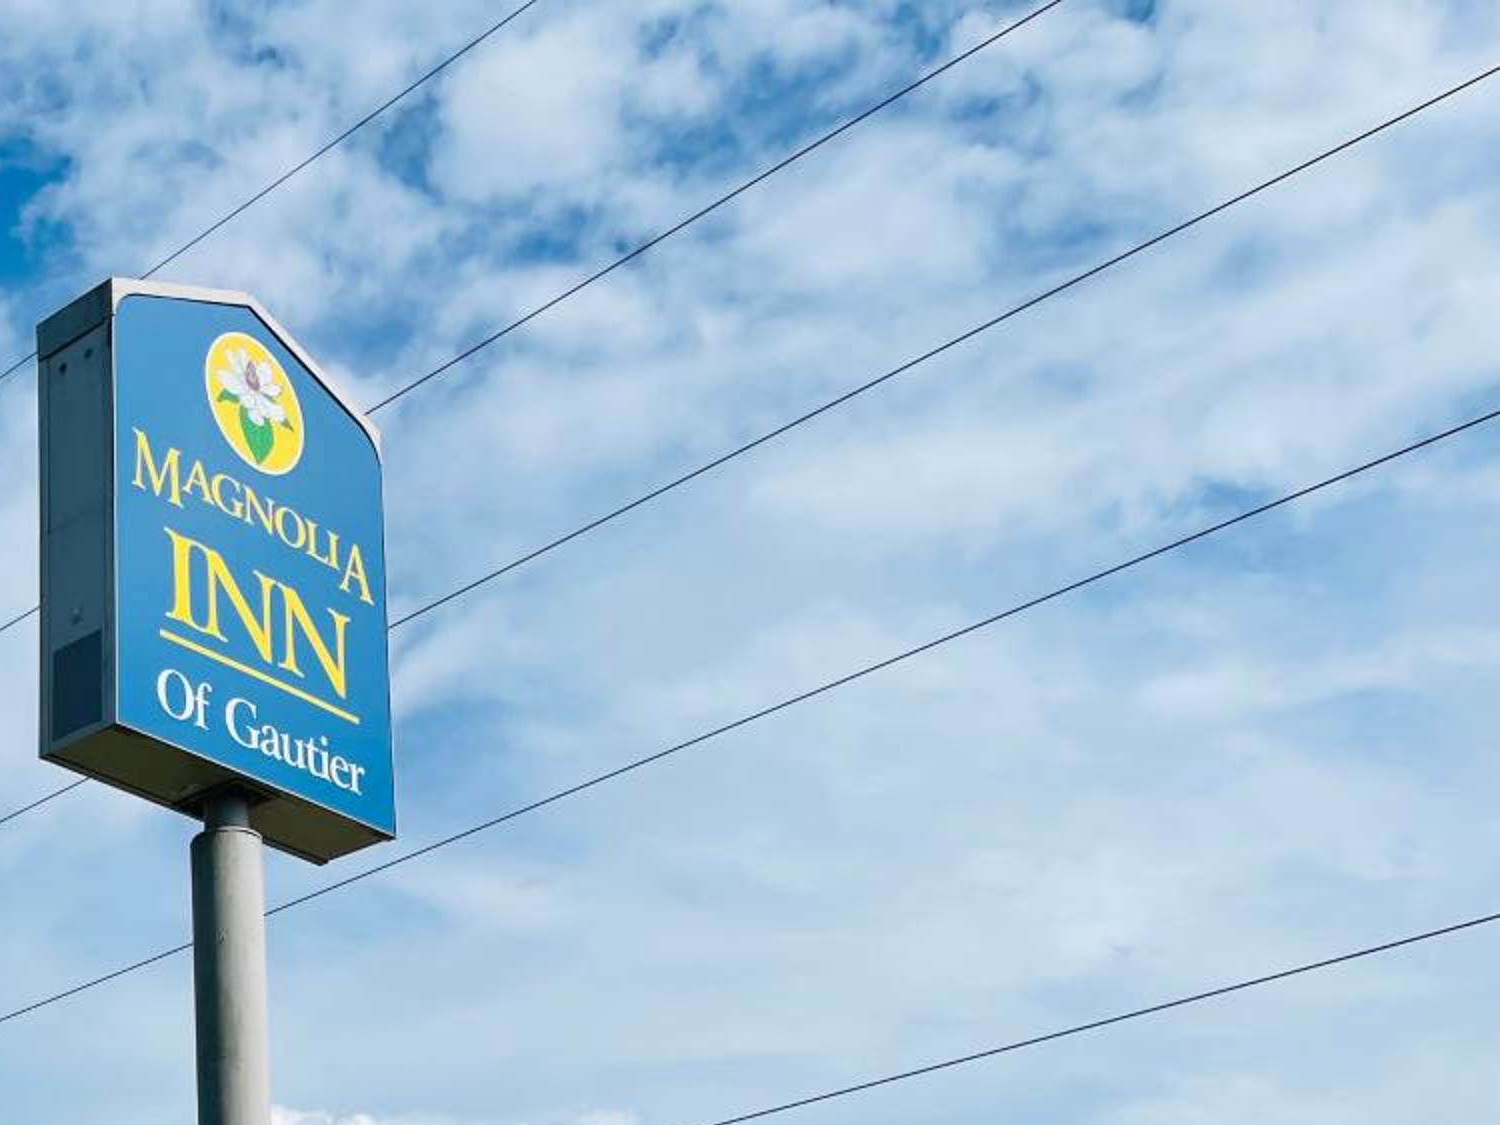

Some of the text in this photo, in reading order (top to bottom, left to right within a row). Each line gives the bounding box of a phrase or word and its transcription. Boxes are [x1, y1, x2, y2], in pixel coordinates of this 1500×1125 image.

[132, 427, 374, 605] MAGNOLIA
[164, 527, 351, 699] INN
[156, 668, 365, 795] Of Gautier
